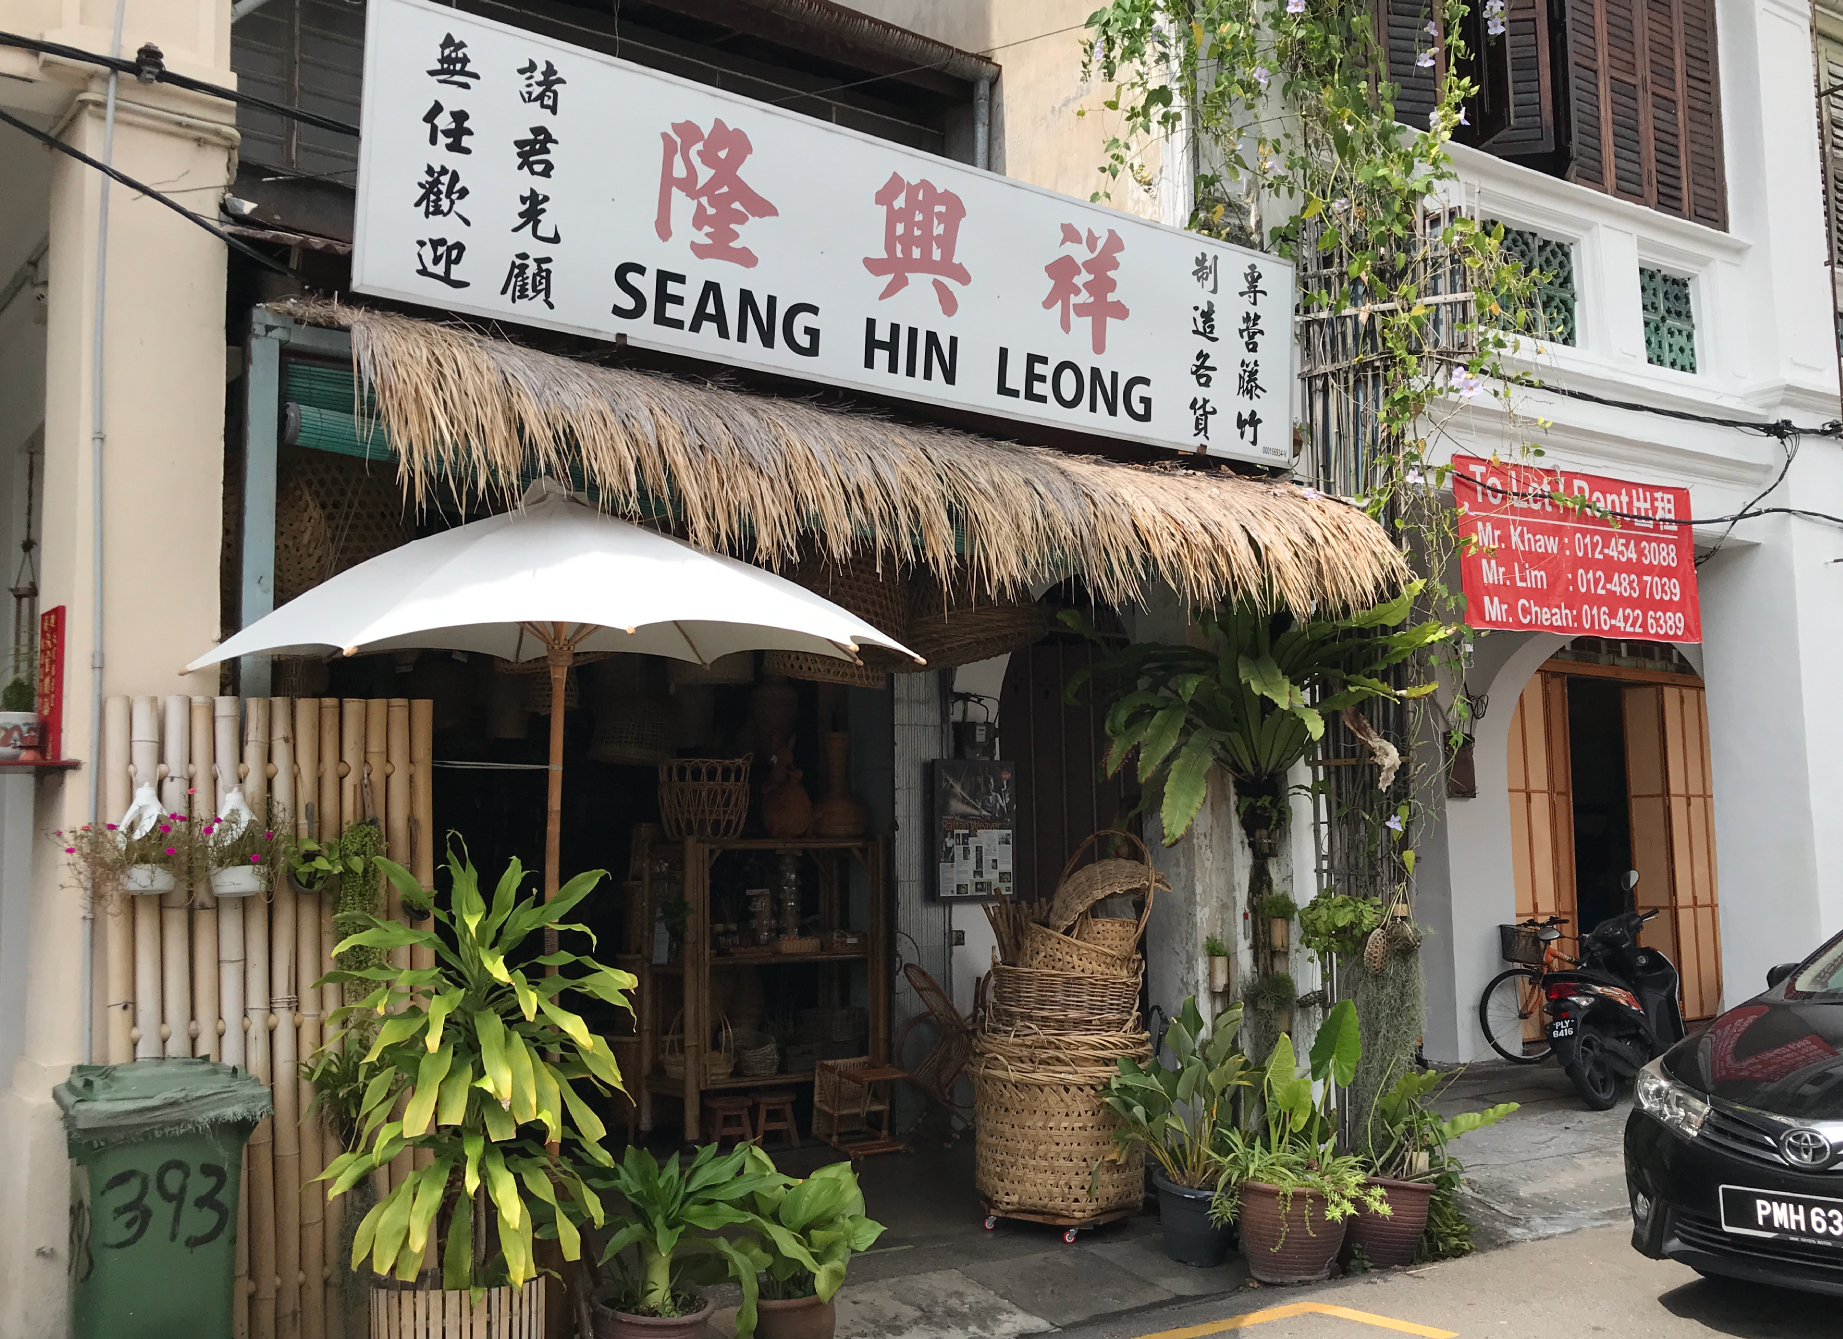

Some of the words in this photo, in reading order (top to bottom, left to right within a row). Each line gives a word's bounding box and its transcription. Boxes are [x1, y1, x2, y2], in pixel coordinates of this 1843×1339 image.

[611, 262, 821, 358] SEANG
[863, 317, 959, 387] HIN
[996, 346, 1152, 423] LEONG
[1469, 464, 1503, 505] To
[1511, 470, 1553, 512] Let
[1573, 479, 1631, 521] Rent
[1632, 487, 1679, 532] 出租
[1477, 521, 1506, 549] Mr.
[1510, 525, 1559, 554] Khaw
[1575, 532, 1637, 563] 012-454
[1641, 540, 1678, 568] 3088
[1481, 558, 1510, 586] Mr.
[1514, 562, 1547, 590] Lim
[1577, 568, 1639, 598] 012-483
[1642, 575, 1680, 602] 7039
[1483, 595, 1513, 623] Mr.
[1517, 598, 1577, 628] Cheah:
[1582, 604, 1644, 633] 016-422
[1647, 610, 1685, 636] 6389
[942, 820, 969, 831] Rattan
[970, 821, 1002, 831] Weaver
[1552, 1027, 1574, 1039] 8416
[1555, 1019, 1570, 1030] PLY
[99, 1159, 229, 1250] 393
[1756, 1199, 1806, 1231] PMH
[1810, 1206, 1843, 1236] 63
